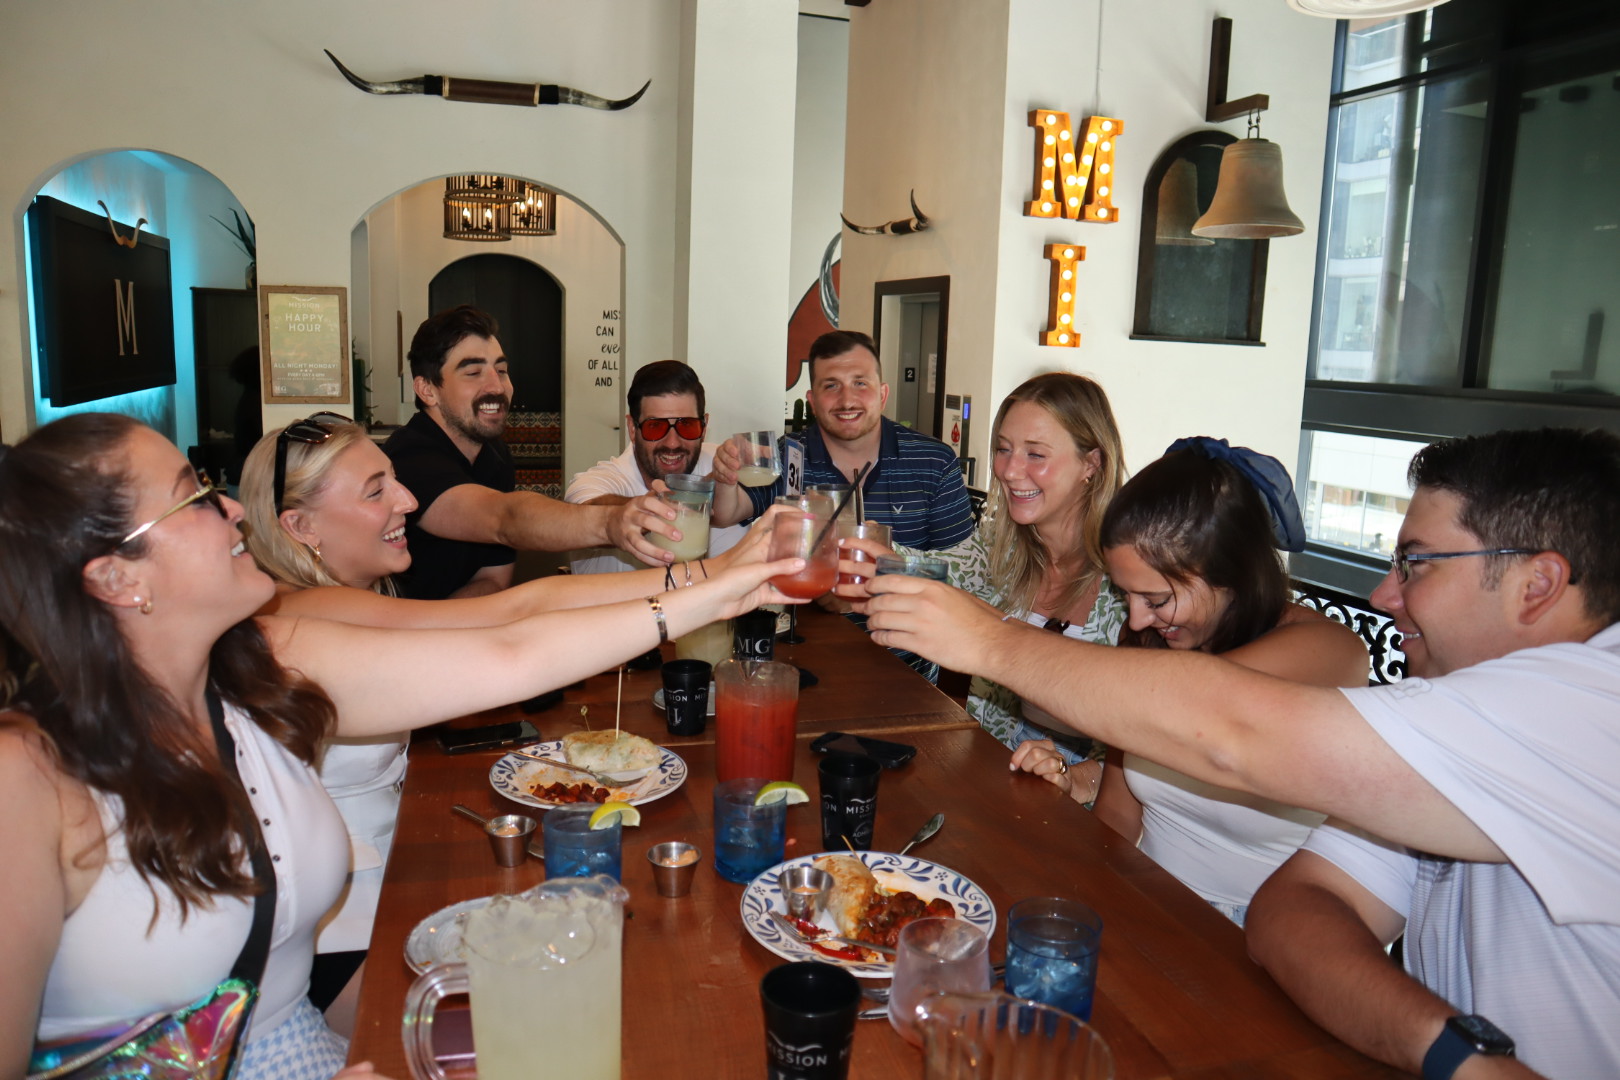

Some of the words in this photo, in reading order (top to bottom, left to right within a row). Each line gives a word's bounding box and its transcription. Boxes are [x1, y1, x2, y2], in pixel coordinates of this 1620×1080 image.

[114, 279, 139, 355] M
[285, 313, 324, 321] HAPPY
[288, 323, 321, 332] HOUR
[595, 326, 614, 336] CAN
[601, 343, 620, 354] eve
[587, 359, 599, 370] OF
[601, 360, 618, 370] ALL
[907, 369, 913, 378] 2
[594, 377, 613, 387] AND
[788, 462, 800, 492] 31
[772, 1046, 828, 1067] ISSION
